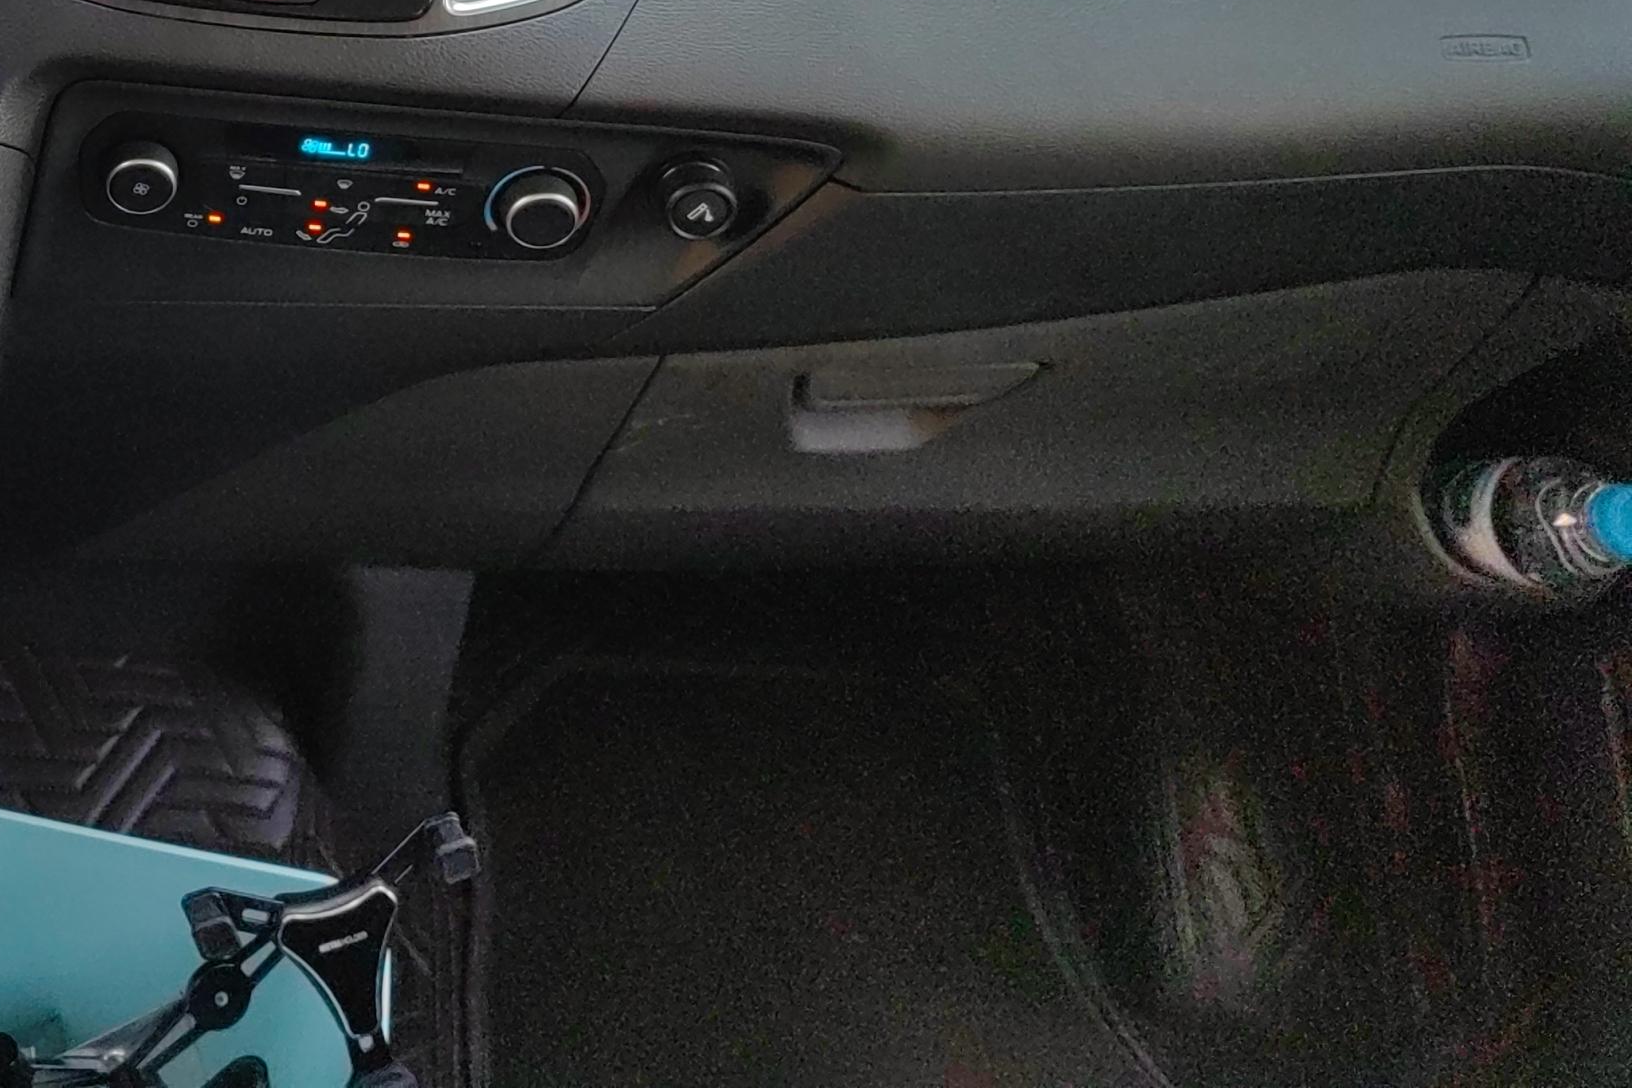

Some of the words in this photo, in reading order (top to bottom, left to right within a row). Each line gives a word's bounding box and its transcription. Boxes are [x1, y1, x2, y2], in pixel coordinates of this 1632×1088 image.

[434, 187, 456, 196] A/C
[424, 209, 451, 218] MAX
[425, 217, 449, 226] A/C
[240, 226, 273, 237] AUTO
